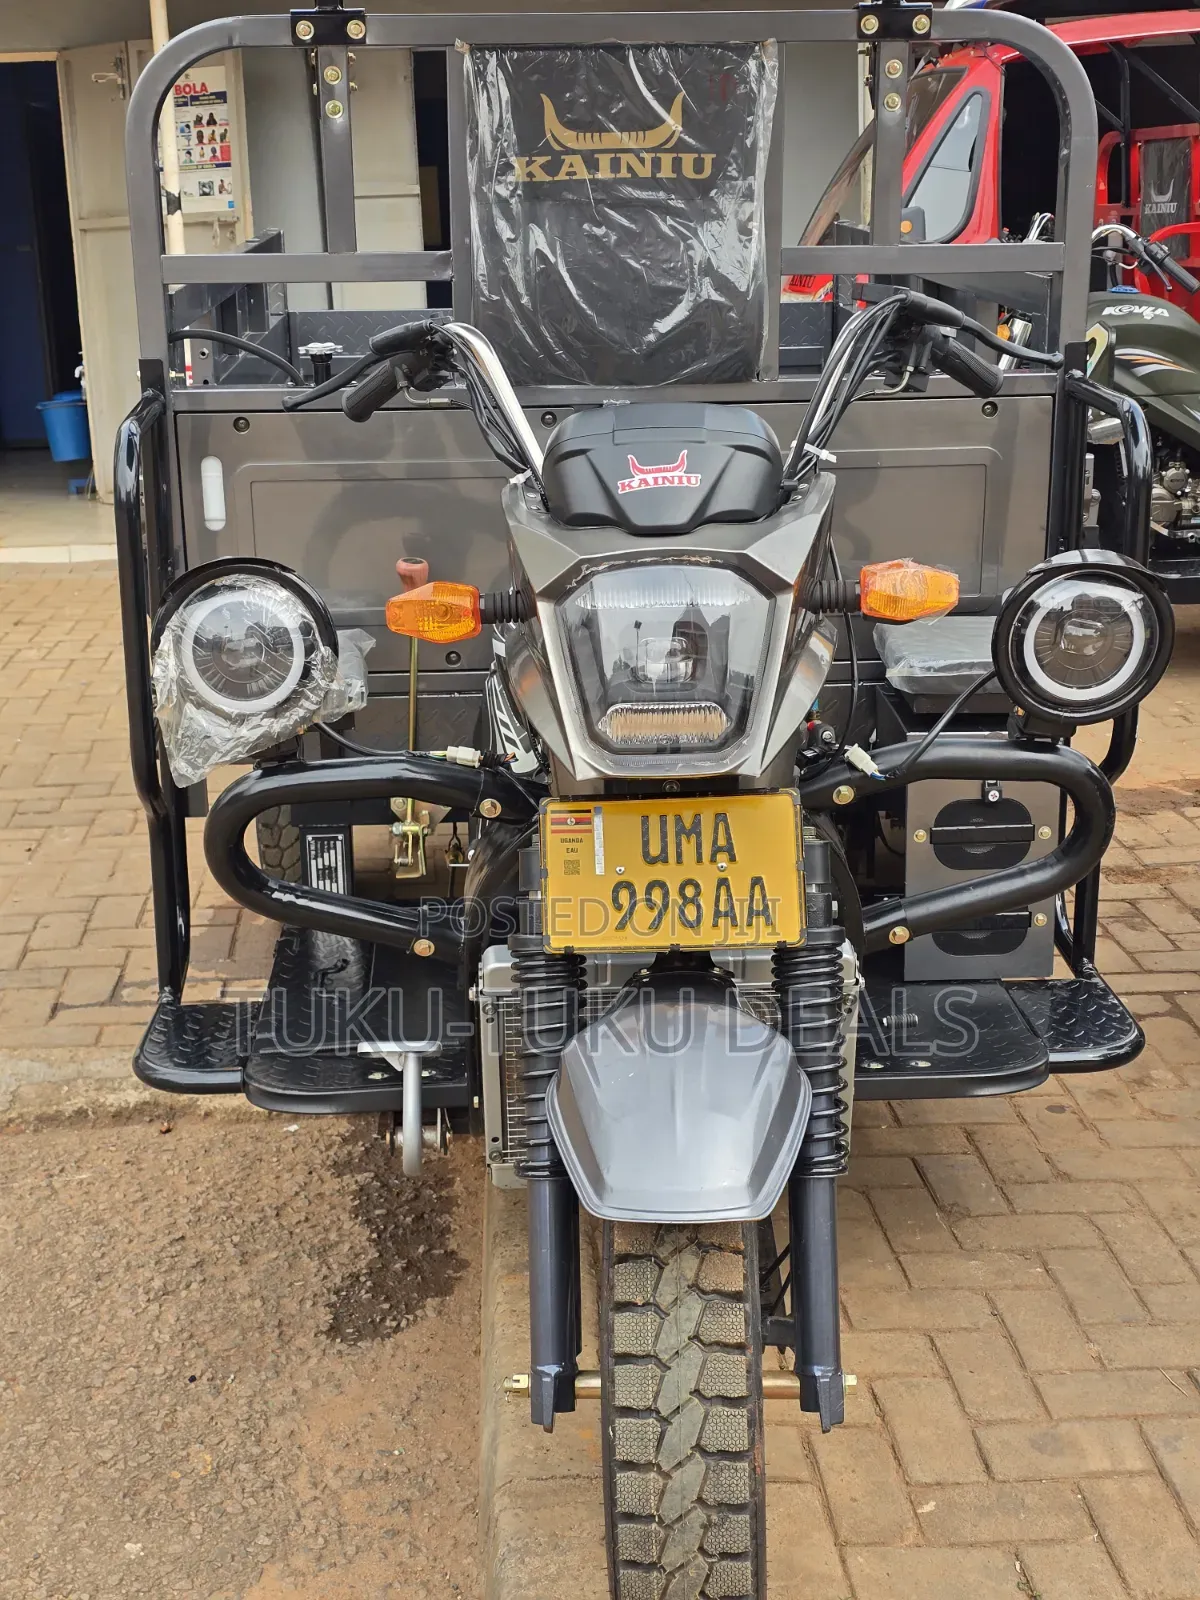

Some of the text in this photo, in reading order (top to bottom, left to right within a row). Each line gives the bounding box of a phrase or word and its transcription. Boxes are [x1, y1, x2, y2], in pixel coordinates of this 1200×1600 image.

[174, 82, 209, 96] BOLA
[515, 152, 717, 182] KAINIU
[1144, 202, 1178, 214] KAINIU
[618, 475, 700, 492] KAINIU
[640, 812, 737, 865] UMA
[611, 876, 773, 931] 998AA
